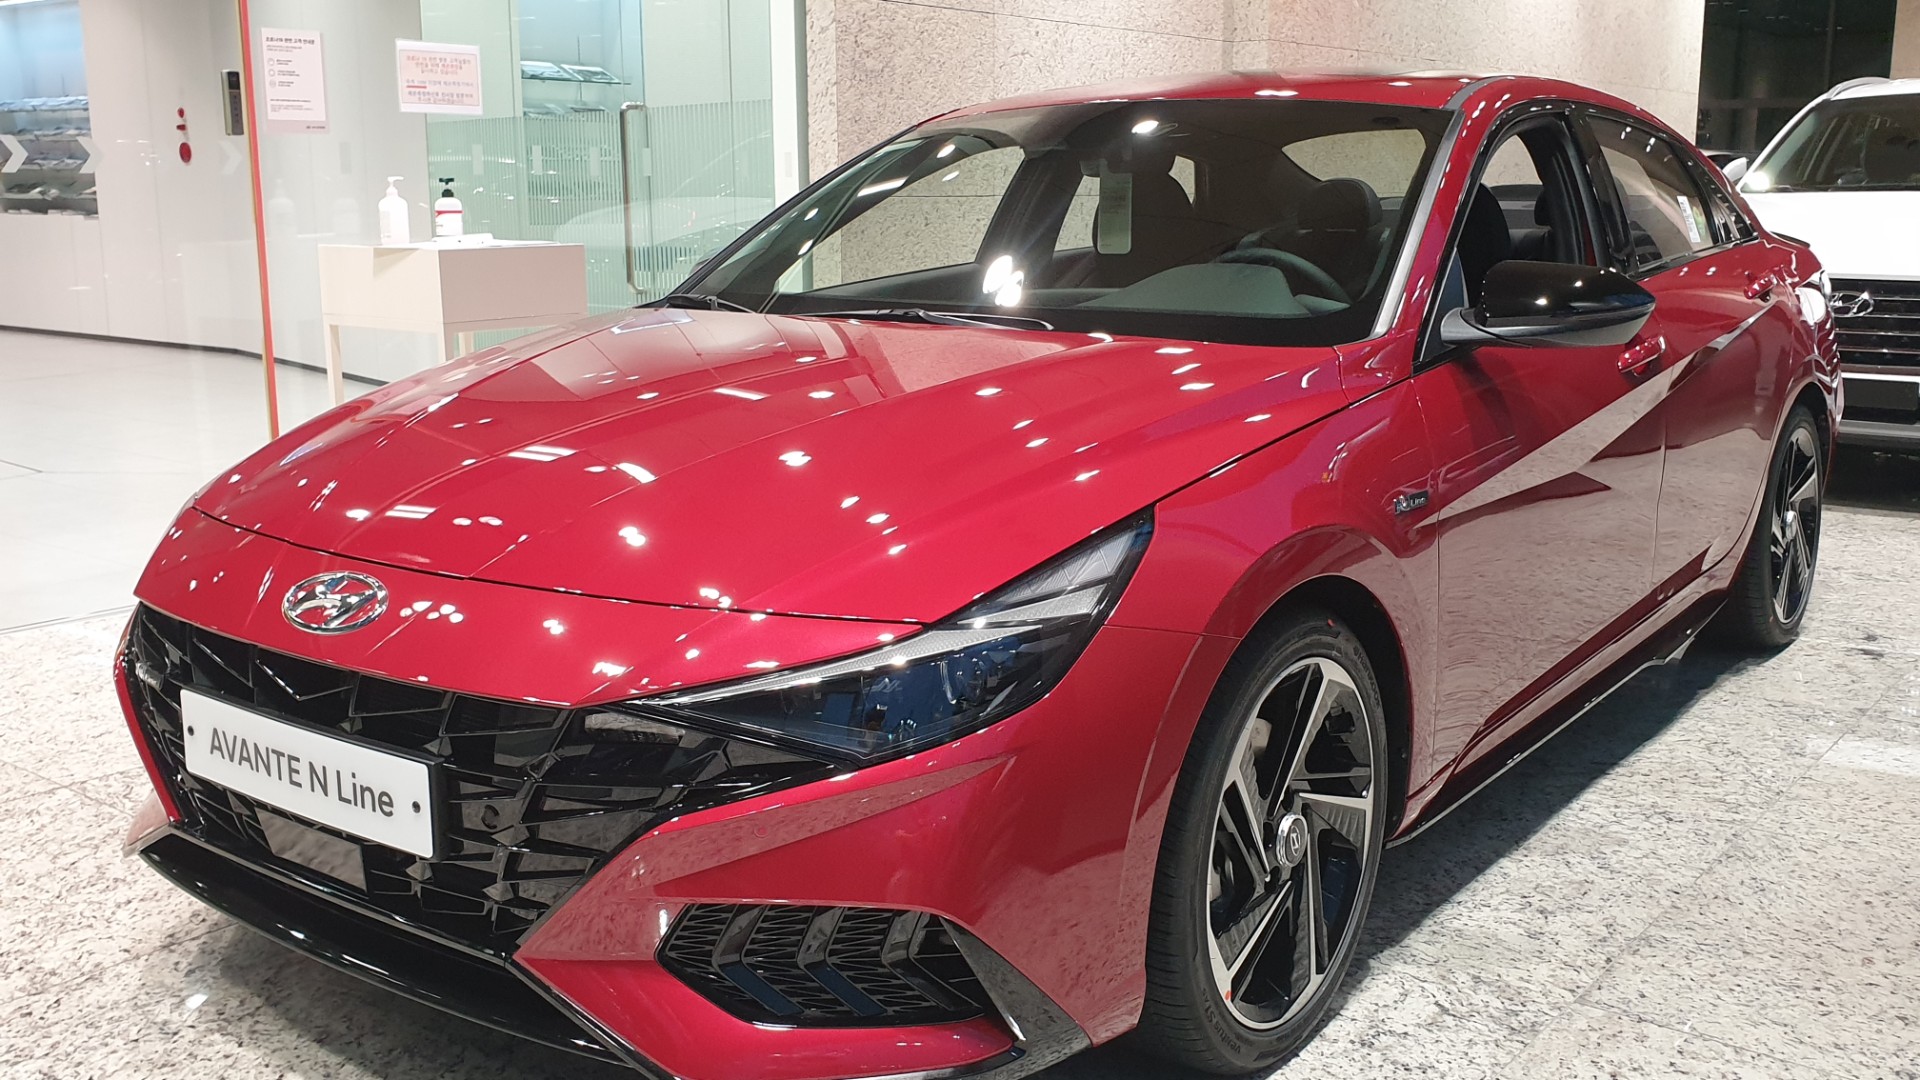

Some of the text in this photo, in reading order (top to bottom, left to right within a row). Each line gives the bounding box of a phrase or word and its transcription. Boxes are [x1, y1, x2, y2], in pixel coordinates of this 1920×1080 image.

[210, 727, 395, 818] AVANTE N Line
